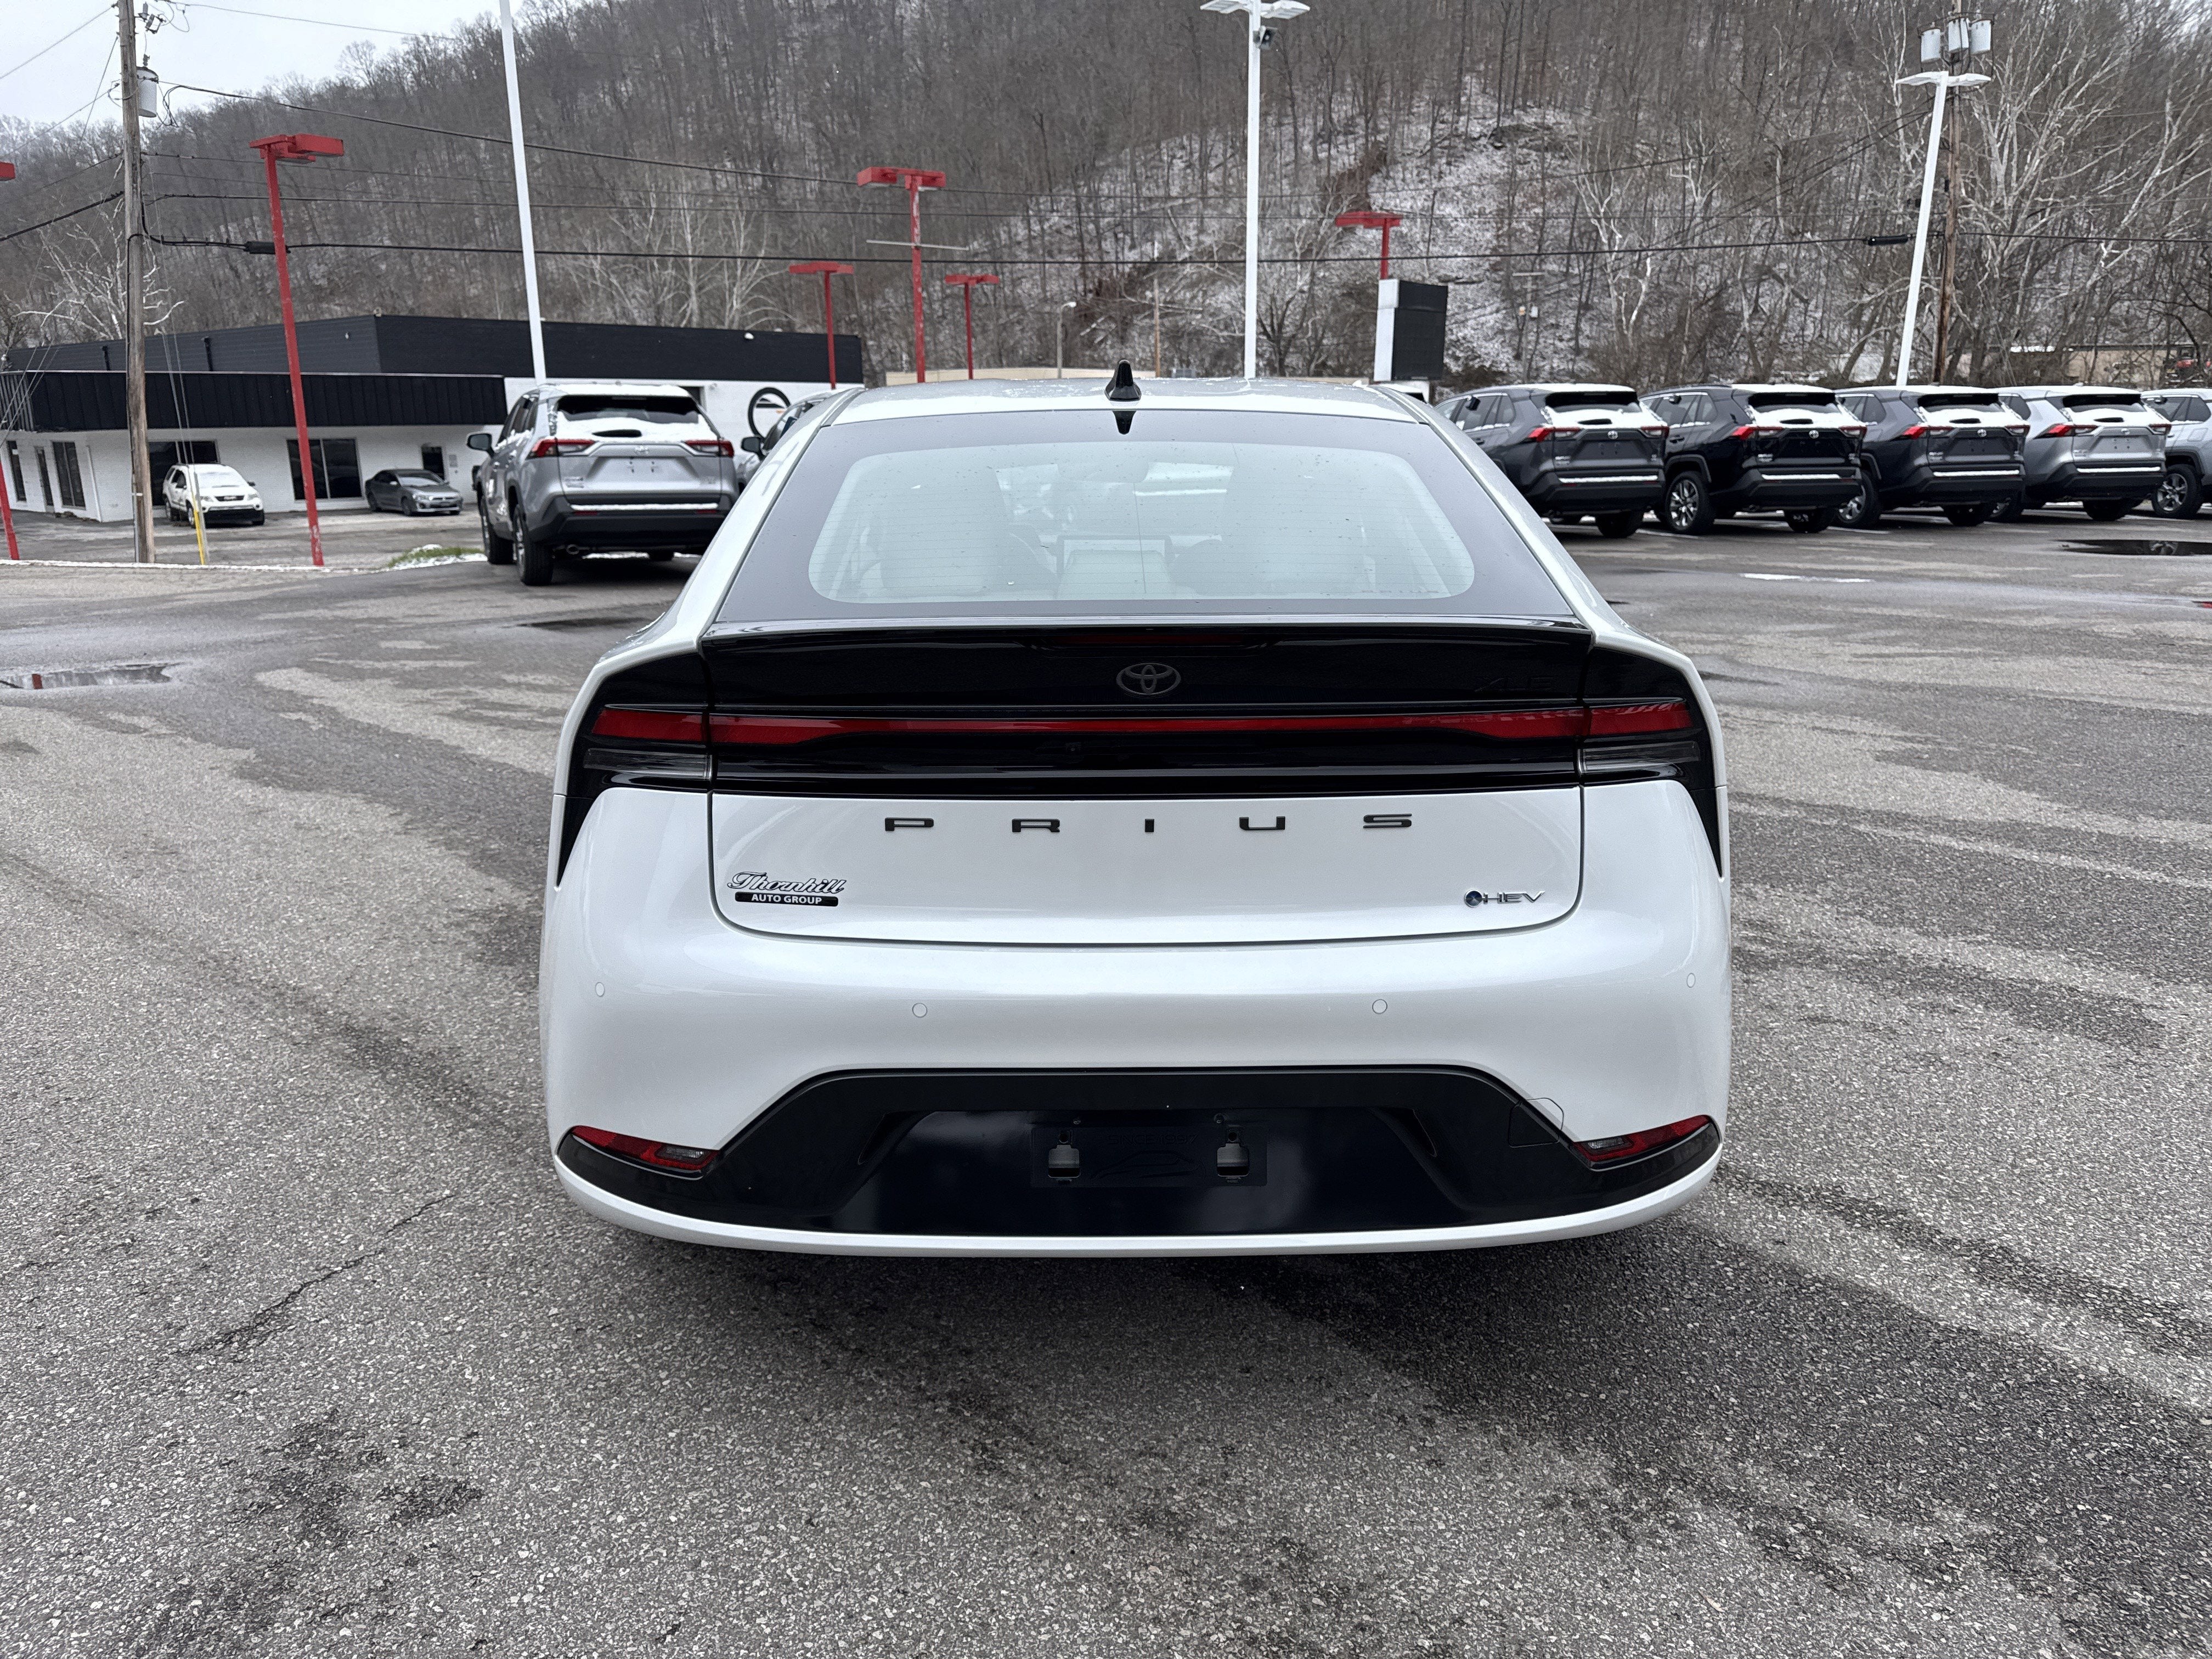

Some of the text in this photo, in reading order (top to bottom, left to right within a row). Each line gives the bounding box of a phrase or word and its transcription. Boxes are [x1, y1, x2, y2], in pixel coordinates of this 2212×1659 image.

[884, 814, 1412, 833] PRIUS
[727, 871, 847, 894] Thornhill
[751, 894, 822, 905] AUTO GROUP
[1483, 891, 1545, 904] HEV
[1107, 1134, 1155, 1146] SINCE
